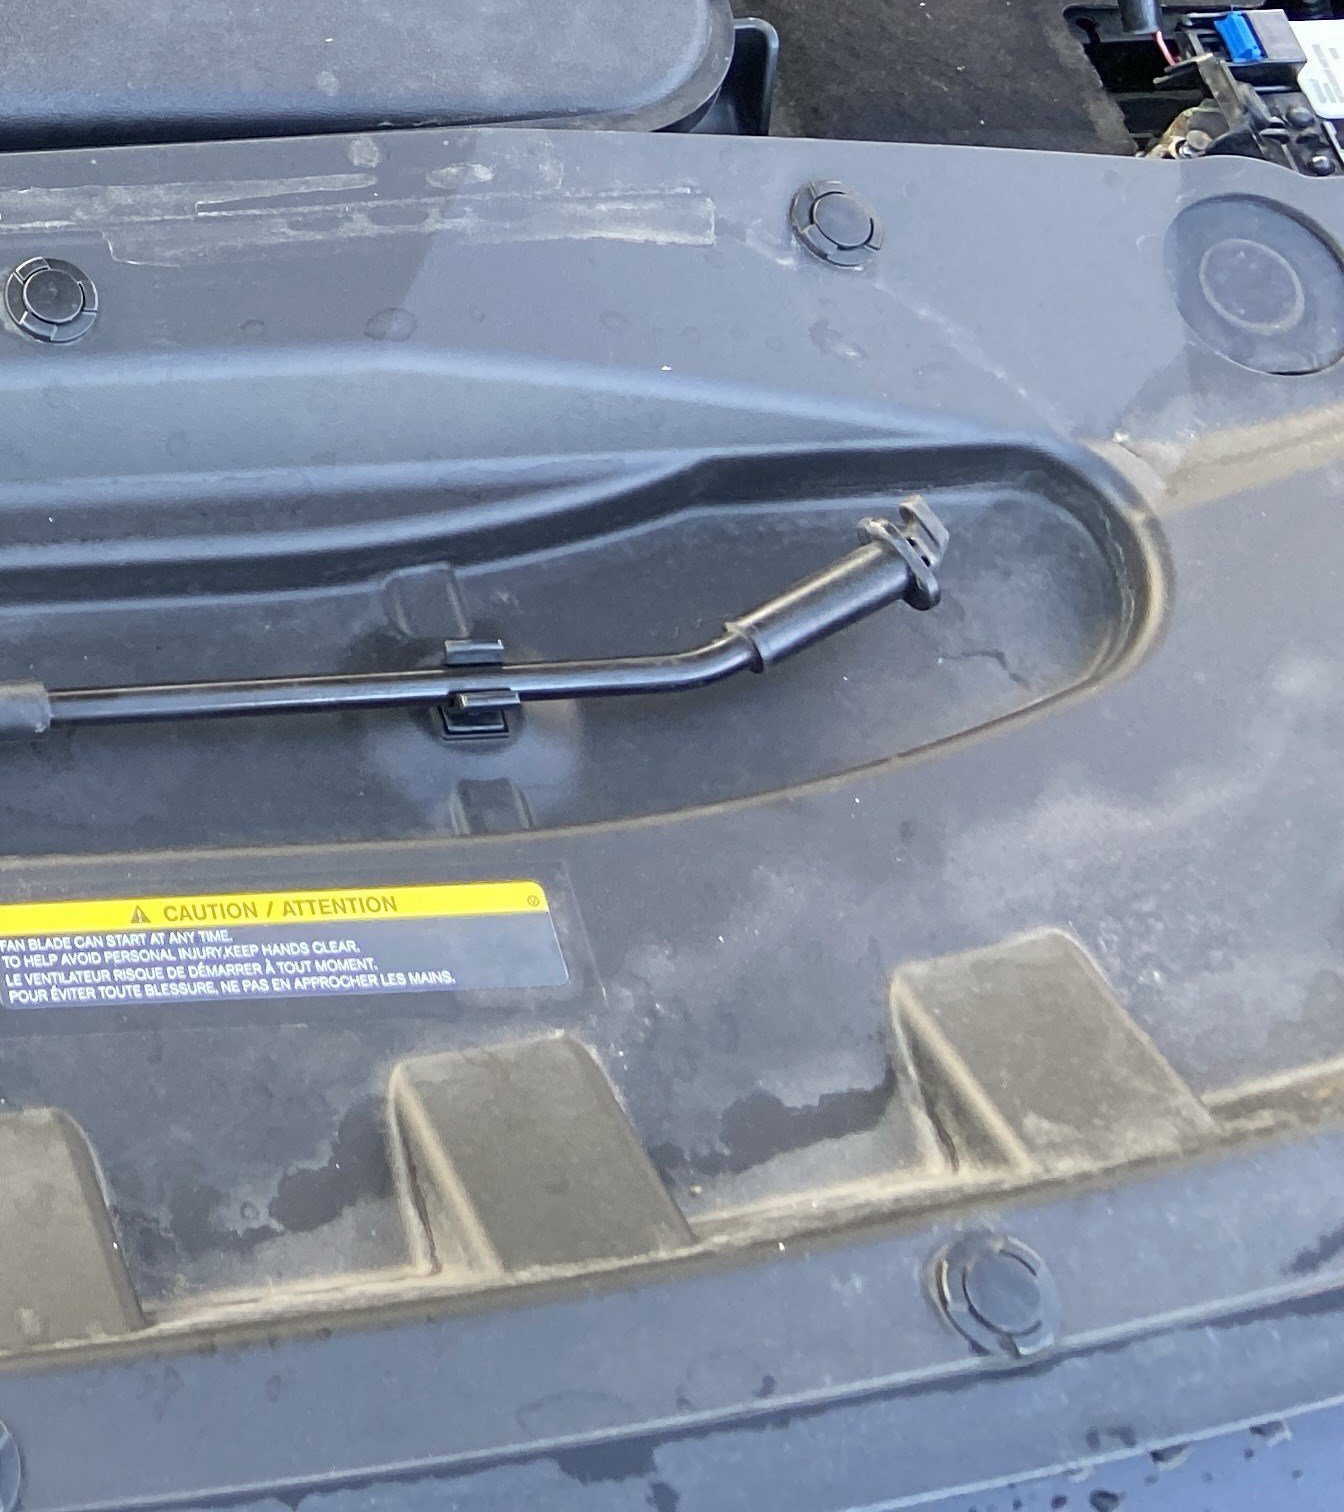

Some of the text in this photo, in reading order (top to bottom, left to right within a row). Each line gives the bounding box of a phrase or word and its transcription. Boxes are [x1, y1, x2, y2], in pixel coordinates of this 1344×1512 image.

[163, 901, 259, 922] CAUTION
[282, 895, 399, 917] ATTENTION
[0, 929, 233, 953] FAN BLADE CAN START AT ANY TIME.
[1, 955, 21, 968] TO
[23, 953, 59, 968] HELP
[60, 951, 102, 966] AVOID
[103, 947, 177, 965] PERSONAL
[262, 941, 310, 957] HANDS
[312, 939, 361, 955] CLEAR.
[5, 957, 379, 987] LE VENTILATEUR RISQUE DE DÉMARRER À TOUT MOMENT.
[8, 989, 49, 1004] POUR
[51, 984, 97, 1002] ÉVITER
[98, 983, 143, 1000] TOUTE
[220, 979, 241, 994] NE
[241, 978, 270, 993] PAS
[271, 978, 291, 993] EN
[294, 974, 379, 992] APPROCHER
[380, 972, 406, 987] LES
[408, 970, 456, 986] MAINS.
